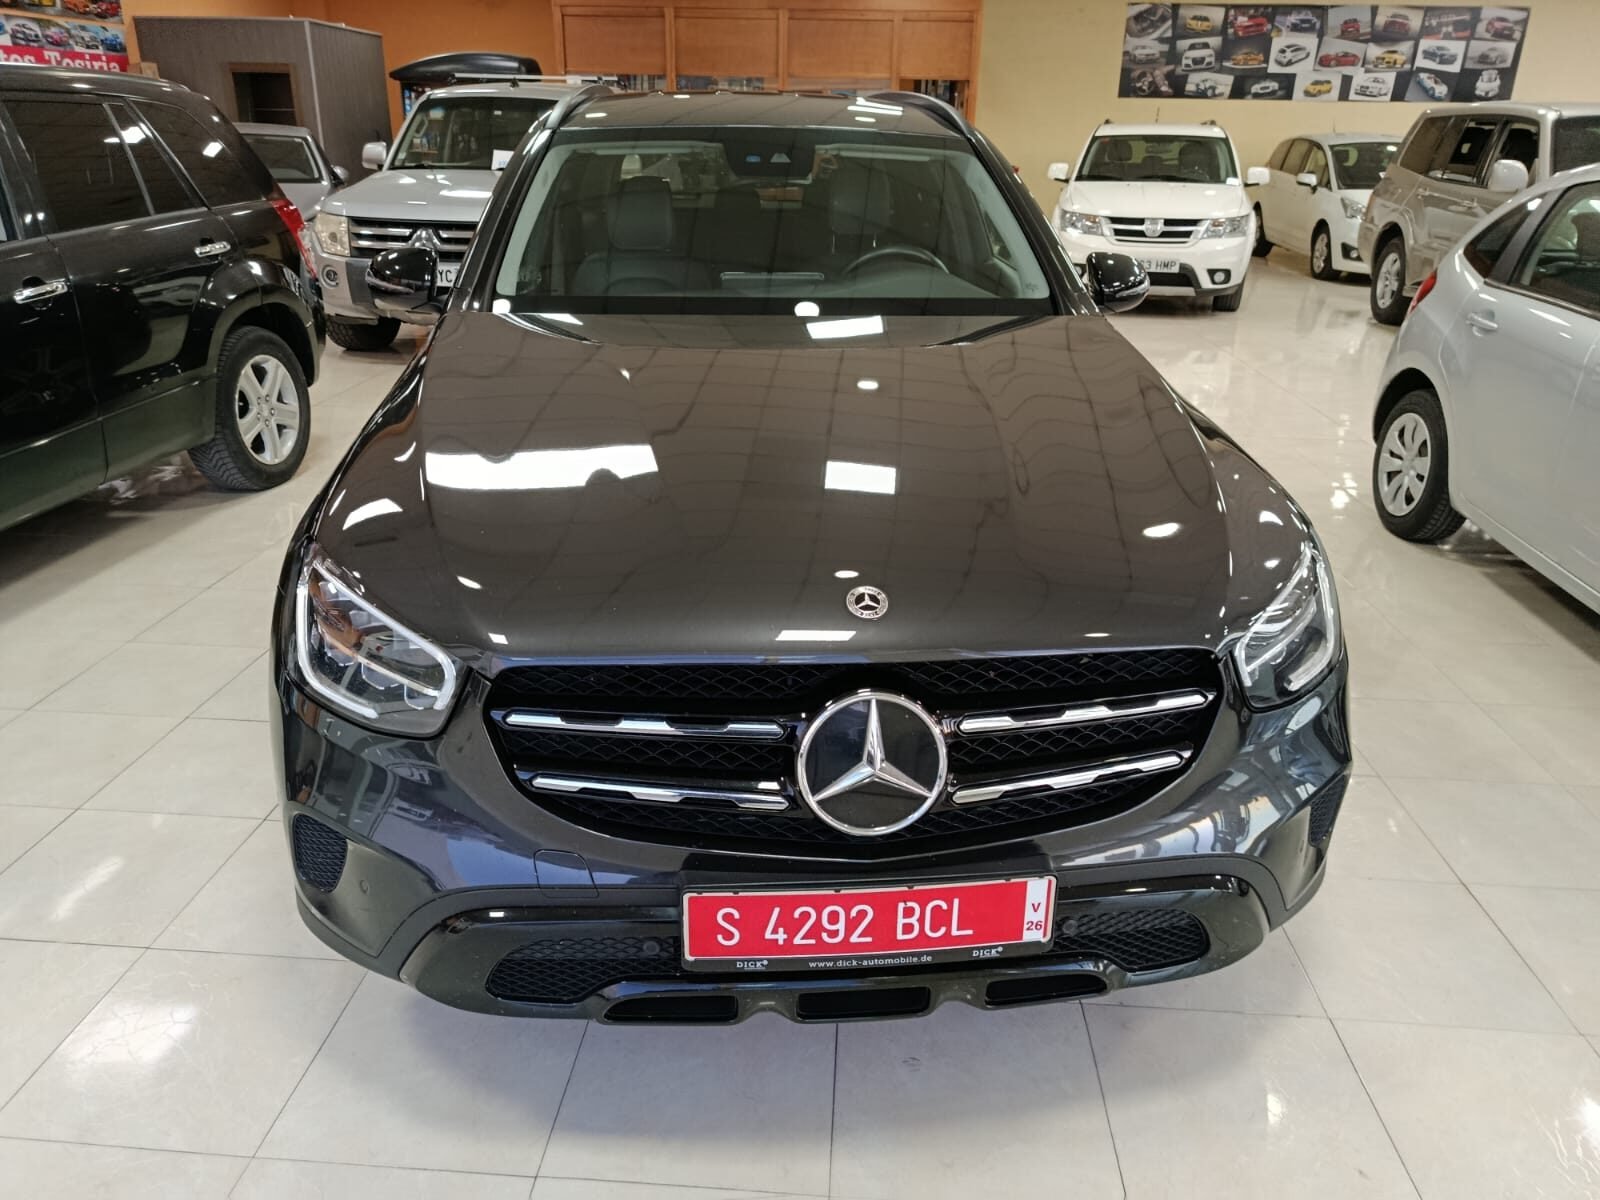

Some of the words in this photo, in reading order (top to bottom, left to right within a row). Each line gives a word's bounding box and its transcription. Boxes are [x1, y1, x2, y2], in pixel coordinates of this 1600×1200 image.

[1155, 259, 1177, 271] HMP
[1031, 902, 1042, 913] V
[716, 907, 741, 946] S
[764, 904, 874, 946] 4292
[896, 898, 974, 940] BCL
[1025, 920, 1043, 931] 26
[808, 953, 933, 968] www.dick-automobile.de
